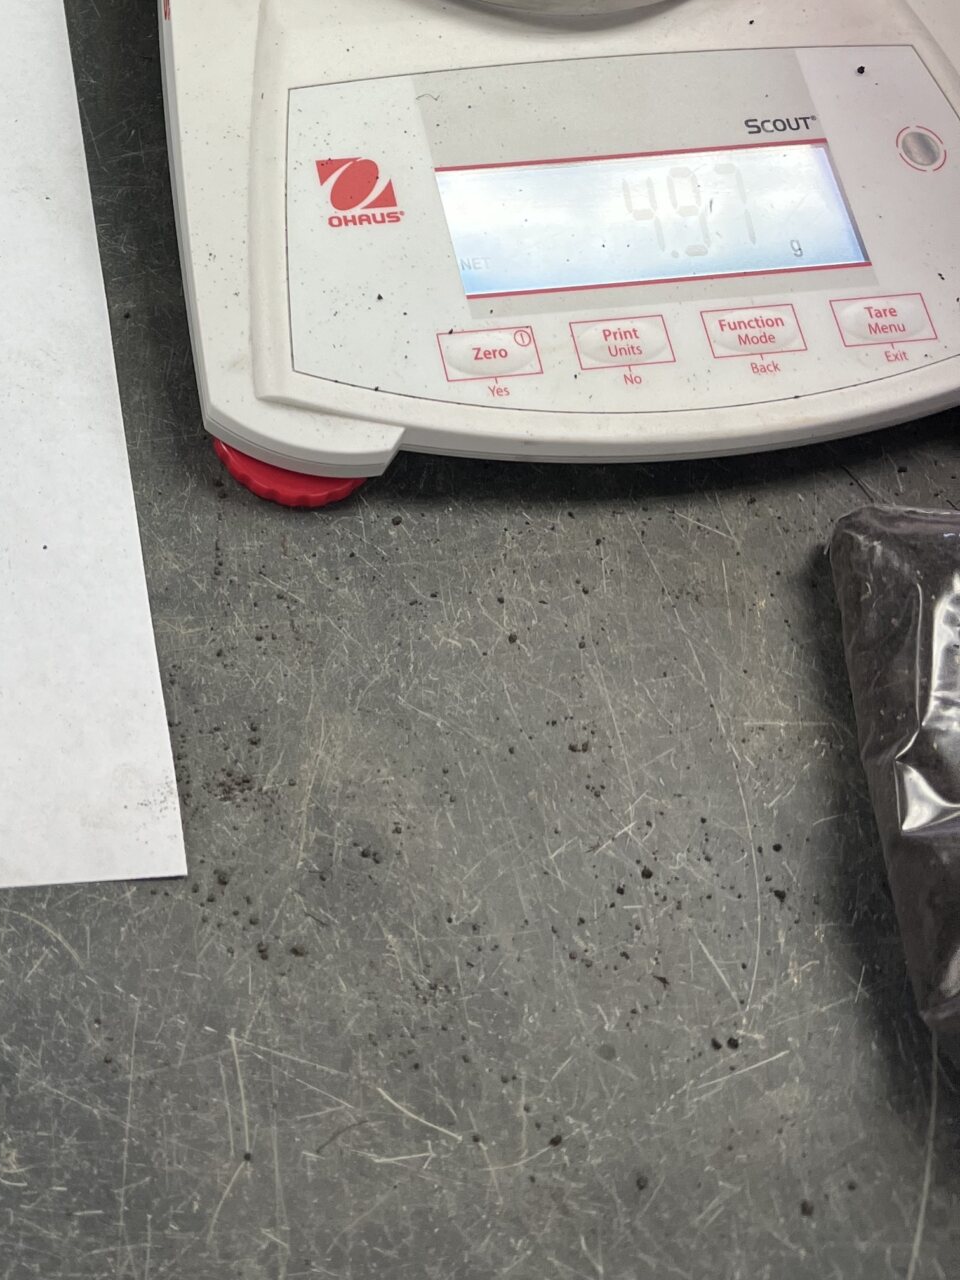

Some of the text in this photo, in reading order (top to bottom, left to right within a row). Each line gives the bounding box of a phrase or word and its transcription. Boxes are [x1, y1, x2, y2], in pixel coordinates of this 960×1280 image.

[622, 163, 804, 259] 4.97 g
[460, 256, 491, 271] NET
[863, 306, 898, 319] Tare
[718, 315, 785, 332] Function
[867, 322, 907, 336] Menu
[602, 327, 640, 343] Print
[737, 332, 776, 346] Mode
[472, 346, 508, 361] Zero
[607, 343, 643, 358] Units
[884, 350, 910, 363] Exit
[750, 360, 781, 375] Back
[623, 373, 643, 386] No
[488, 384, 510, 398] Yes
